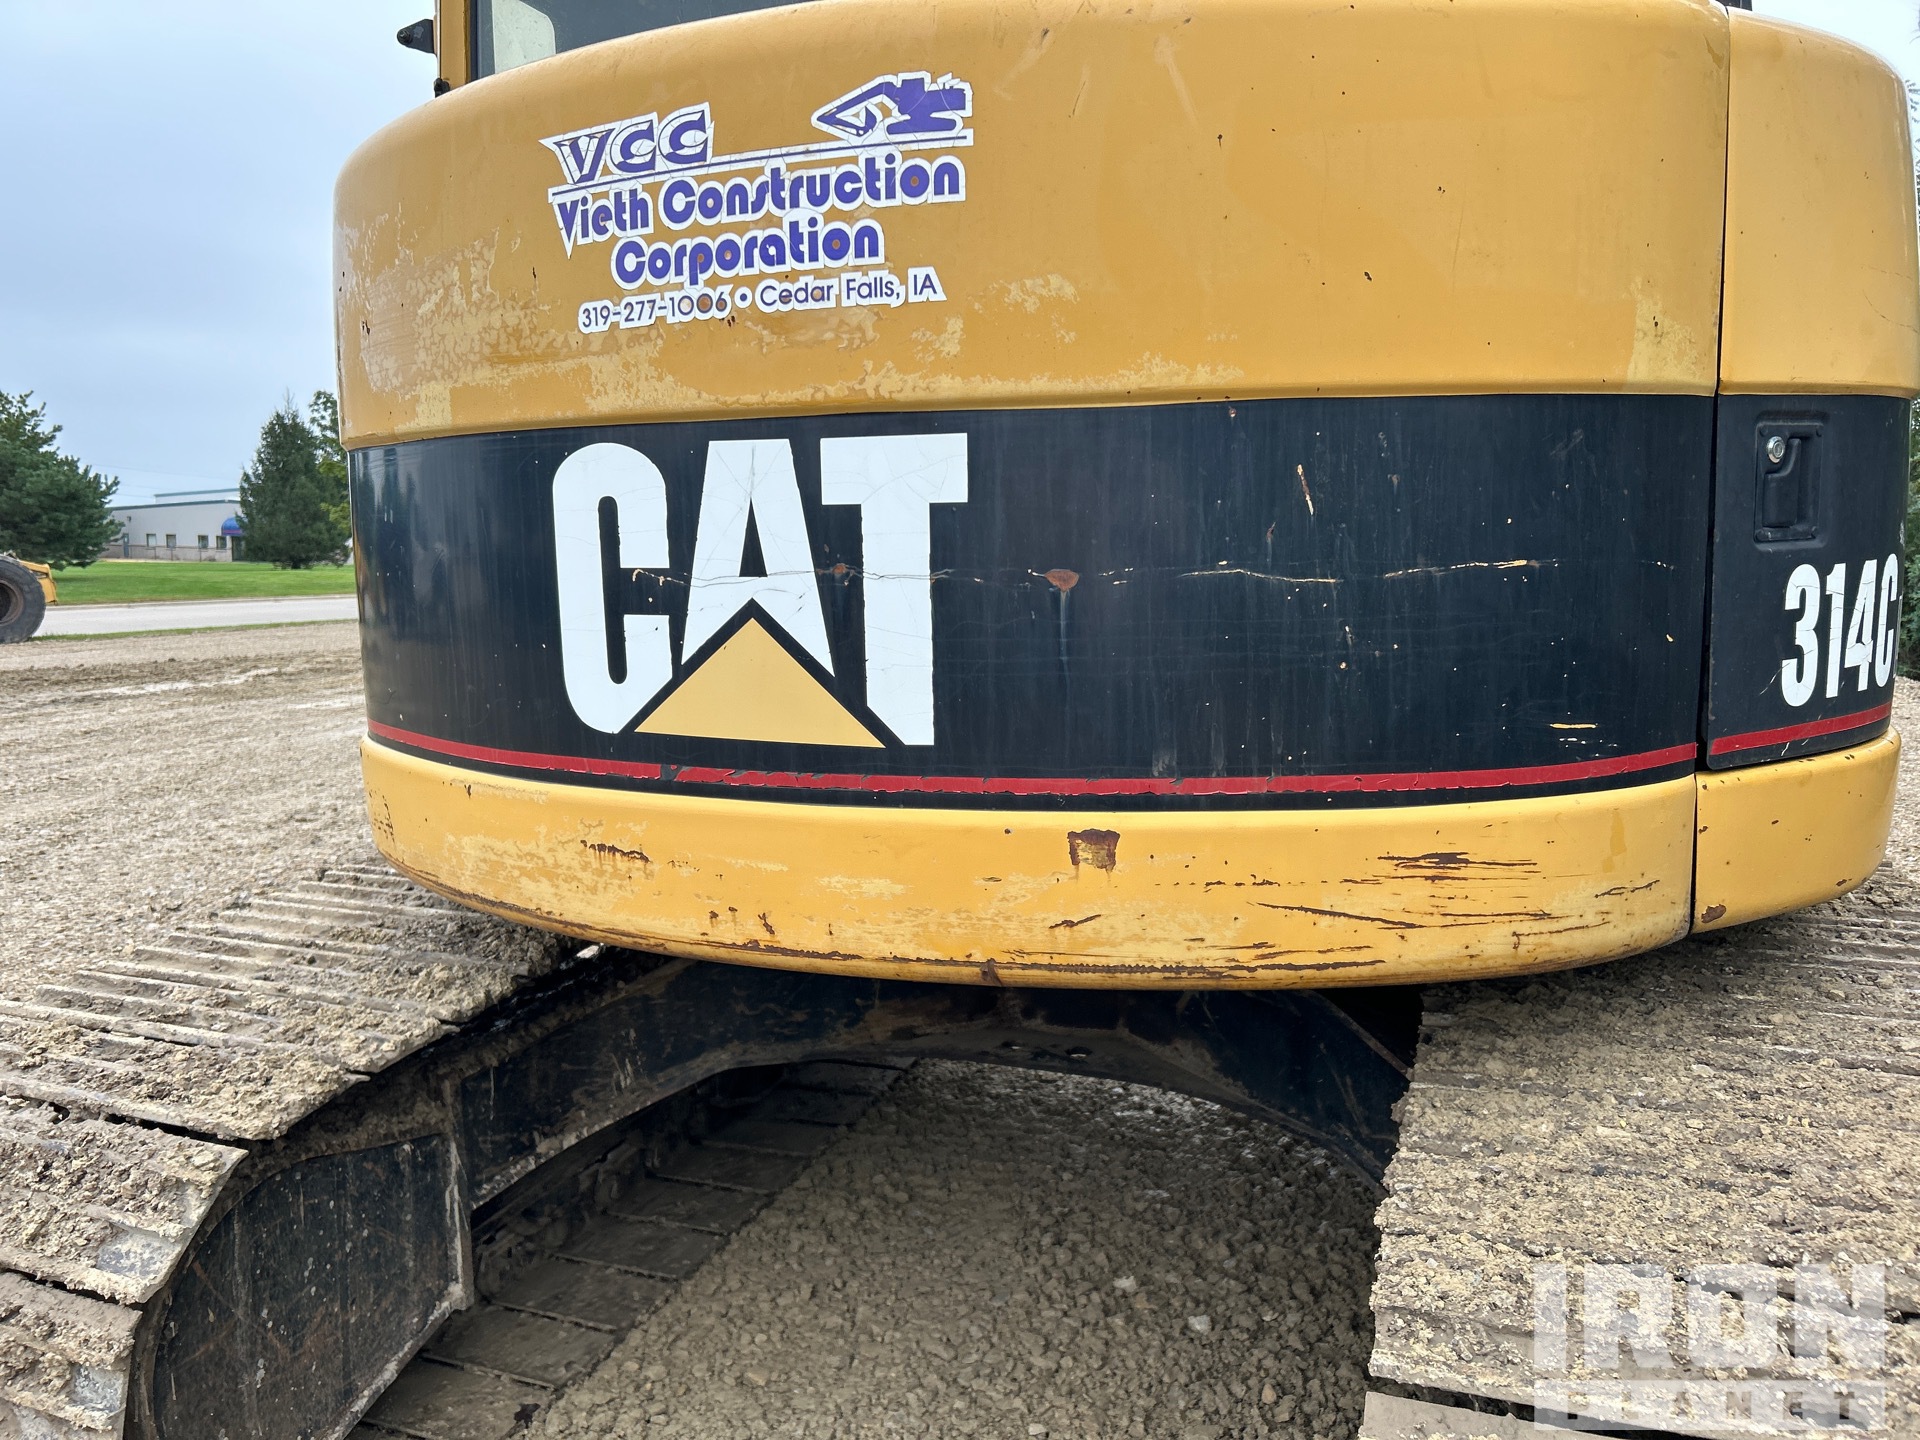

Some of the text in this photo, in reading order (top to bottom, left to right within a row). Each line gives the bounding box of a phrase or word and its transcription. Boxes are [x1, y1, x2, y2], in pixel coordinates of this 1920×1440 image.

[553, 110, 709, 184] VCC
[558, 152, 961, 247] Vieth Construction
[614, 215, 881, 286] Corporation
[581, 273, 938, 328] 319-277-1006 Cedar Falls, IA
[552, 432, 968, 746] CAT
[1781, 553, 1899, 707] 314C
